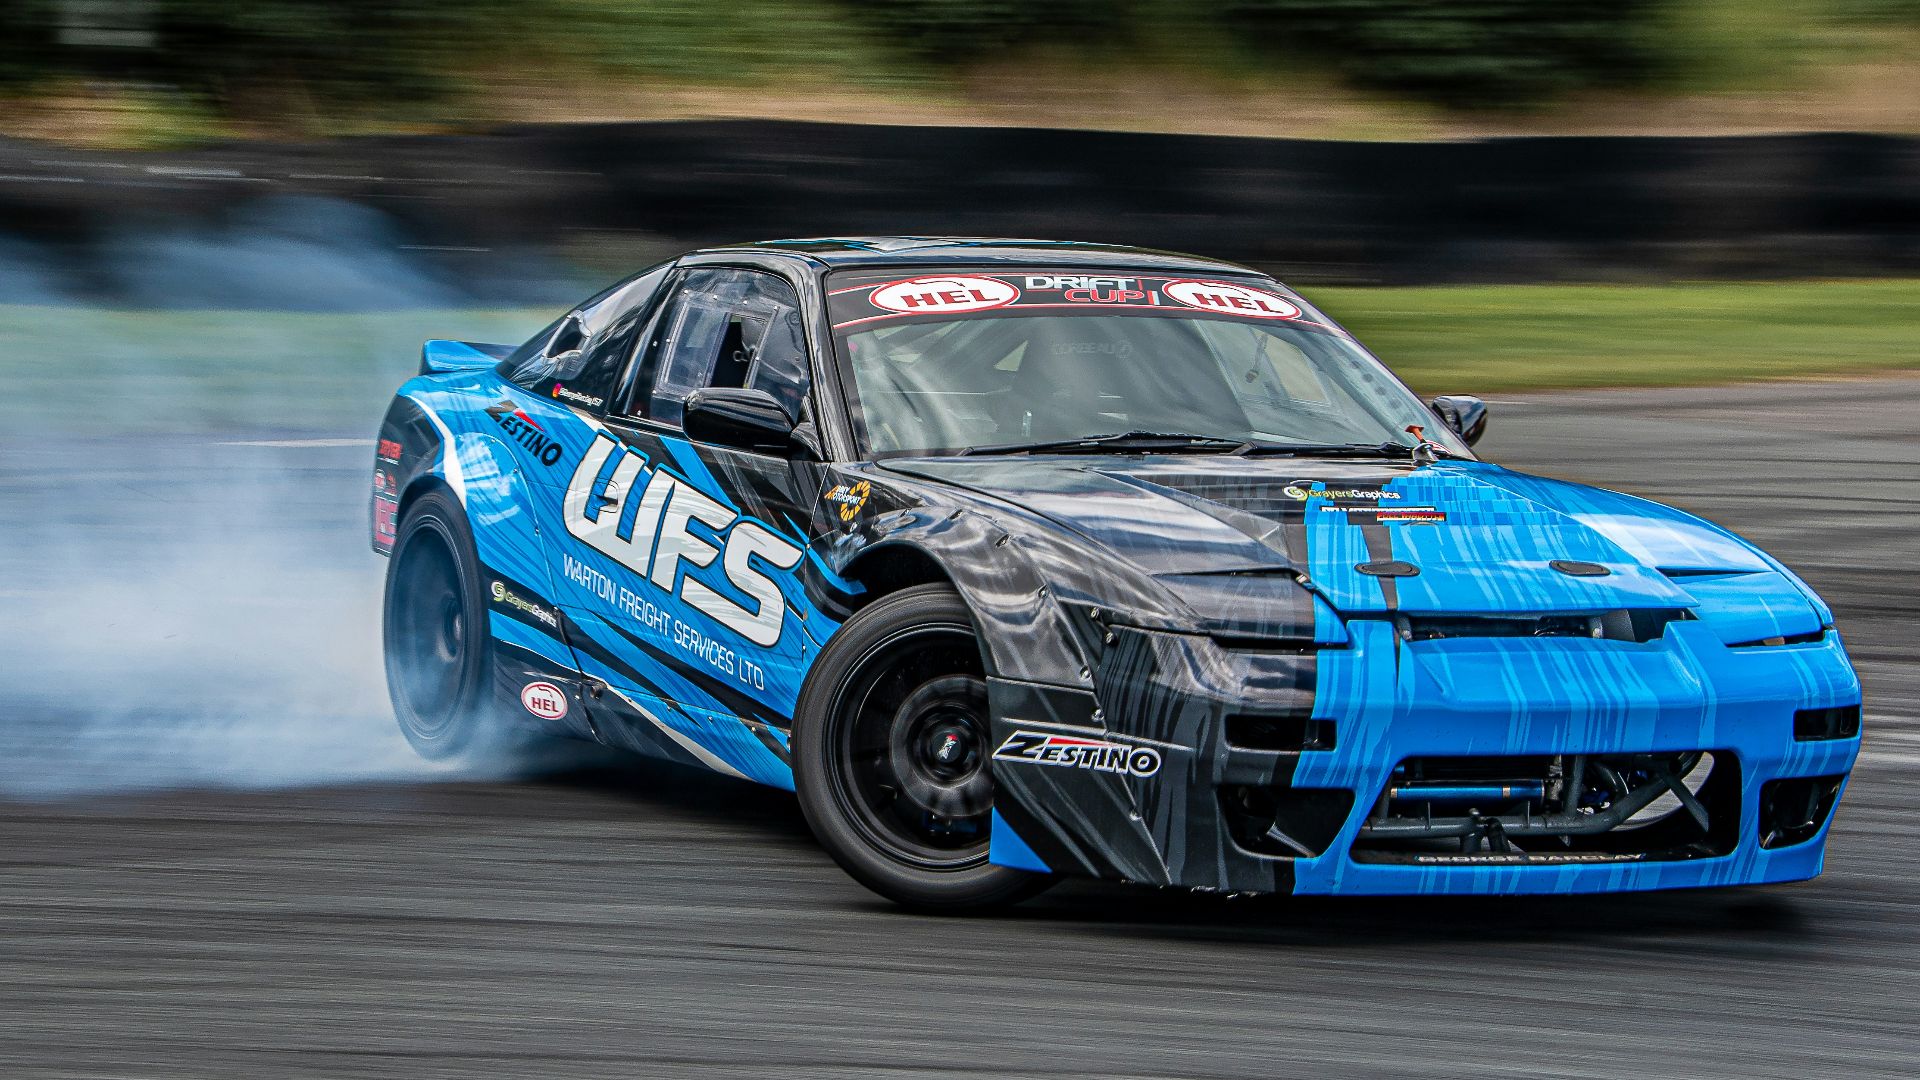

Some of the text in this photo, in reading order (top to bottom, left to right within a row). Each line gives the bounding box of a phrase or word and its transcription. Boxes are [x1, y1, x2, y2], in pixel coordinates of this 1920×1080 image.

[1024, 275, 1136, 291] DRIFT
[901, 287, 1000, 308] HEL
[1064, 288, 1145, 304] CUP
[1195, 291, 1284, 315] HEL
[484, 399, 562, 466] ZESTINO
[563, 434, 804, 647] WFS
[563, 553, 765, 691] WARTON FREIGHT SERVICES LTD
[531, 696, 559, 713] HEL
[993, 730, 1161, 778] ZESTINO
